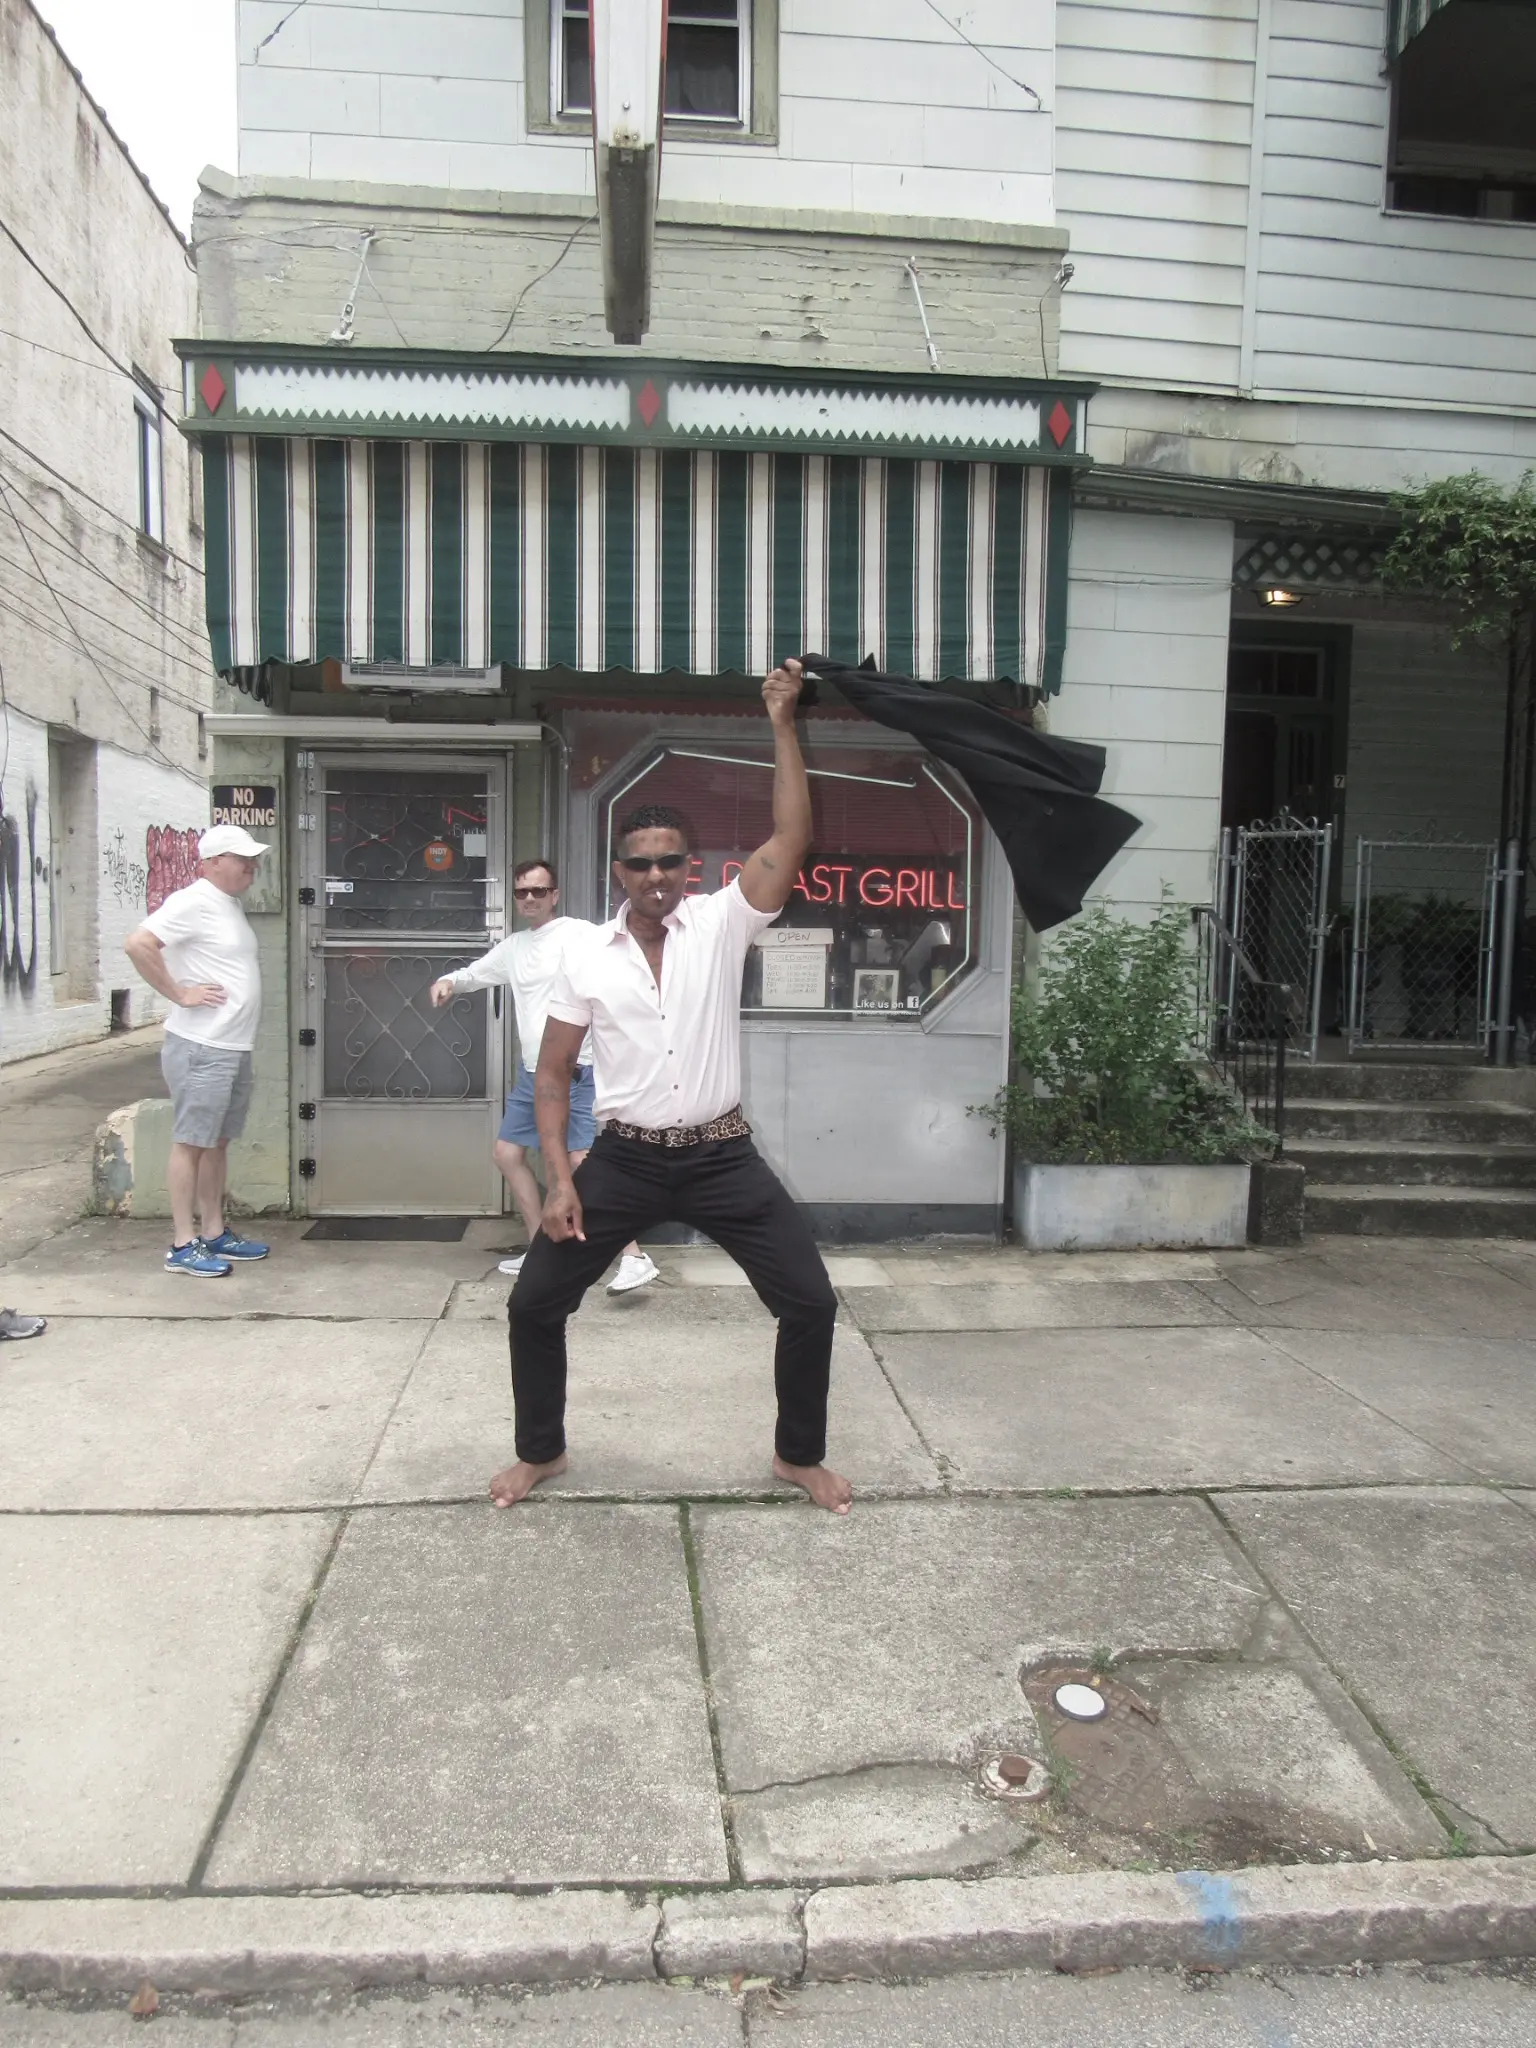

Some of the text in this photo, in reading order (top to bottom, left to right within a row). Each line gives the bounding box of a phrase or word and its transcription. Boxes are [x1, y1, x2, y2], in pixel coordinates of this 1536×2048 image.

[1336, 775, 1344, 786] 7
[233, 787, 255, 806] NO
[213, 807, 276, 827] PARKING
[429, 847, 448, 856] INDY
[859, 867, 965, 909] GRILL
[778, 931, 811, 943] OPEN
[855, 999, 875, 1008] Like
[877, 1001, 889, 1009] us
[892, 1001, 904, 1009] on
